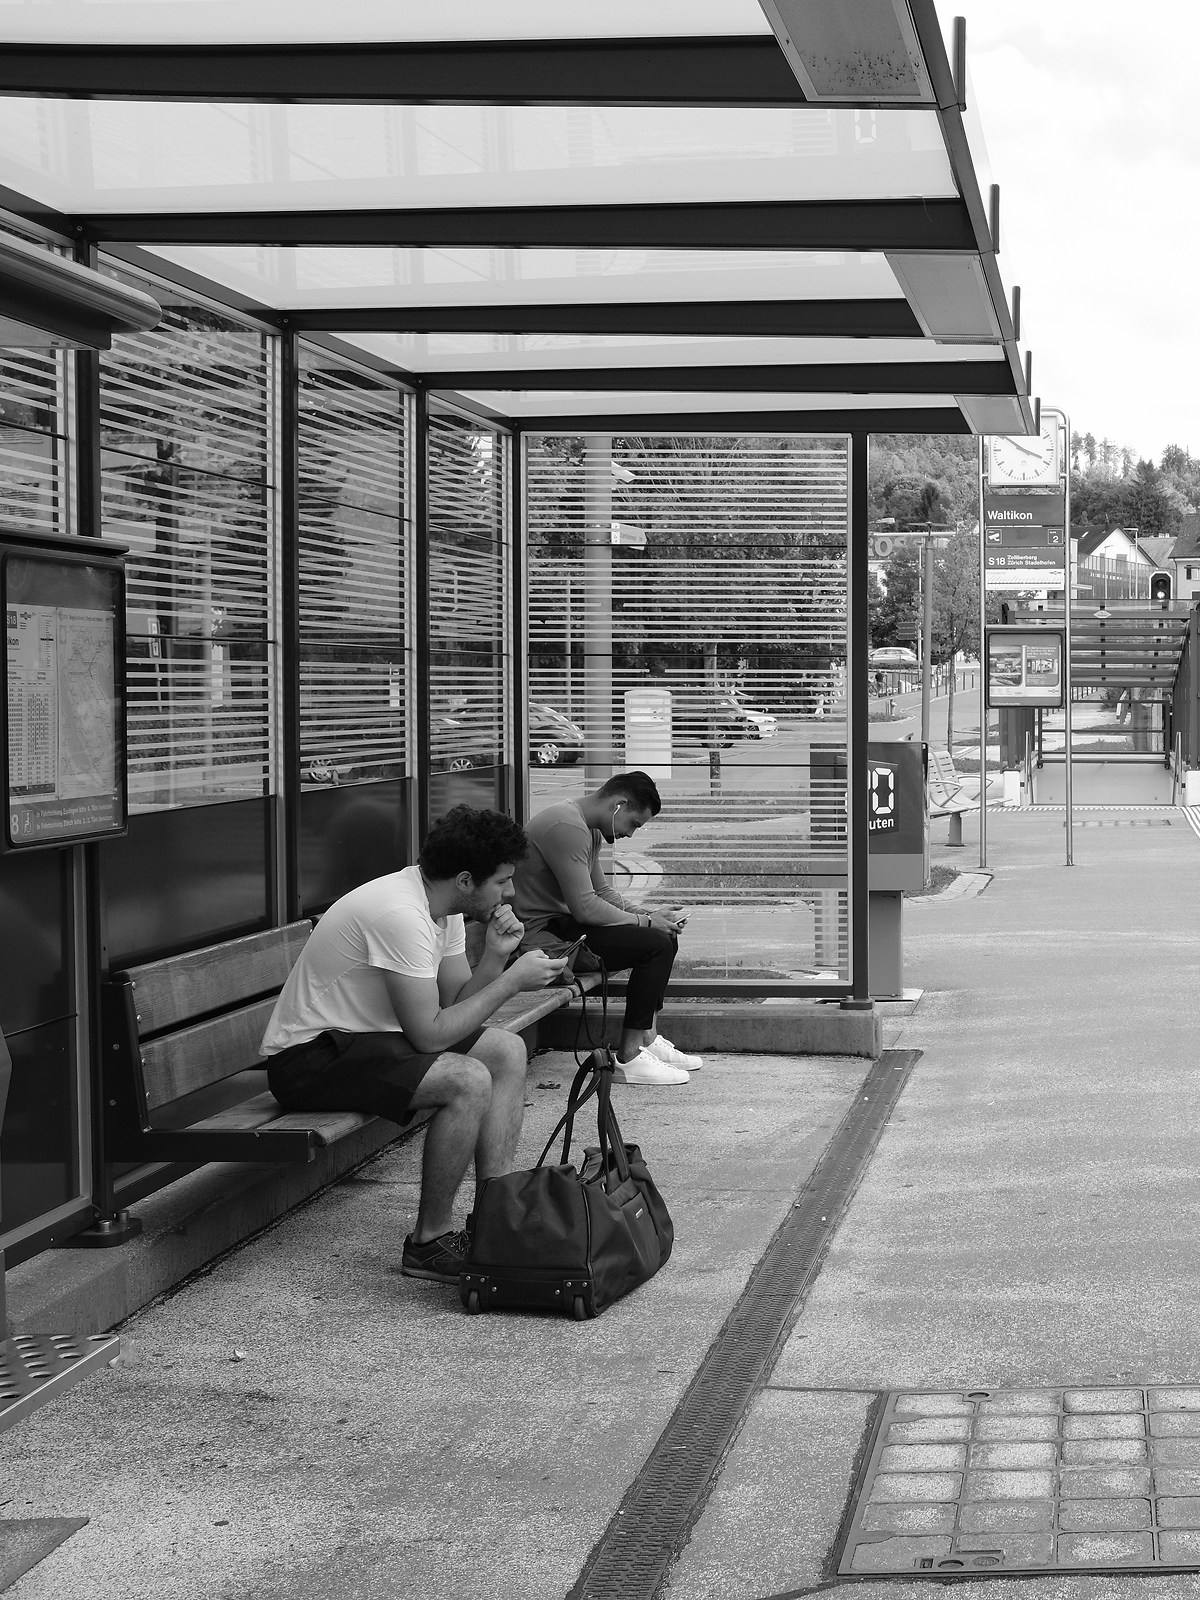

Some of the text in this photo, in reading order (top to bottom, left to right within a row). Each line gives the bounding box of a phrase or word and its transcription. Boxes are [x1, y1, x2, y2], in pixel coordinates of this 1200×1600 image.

[987, 510, 1033, 520] Waltikon
[1052, 535, 1059, 543] 2
[7, 637, 20, 646] ikon
[867, 767, 894, 815] 0
[869, 817, 894, 831] uten
